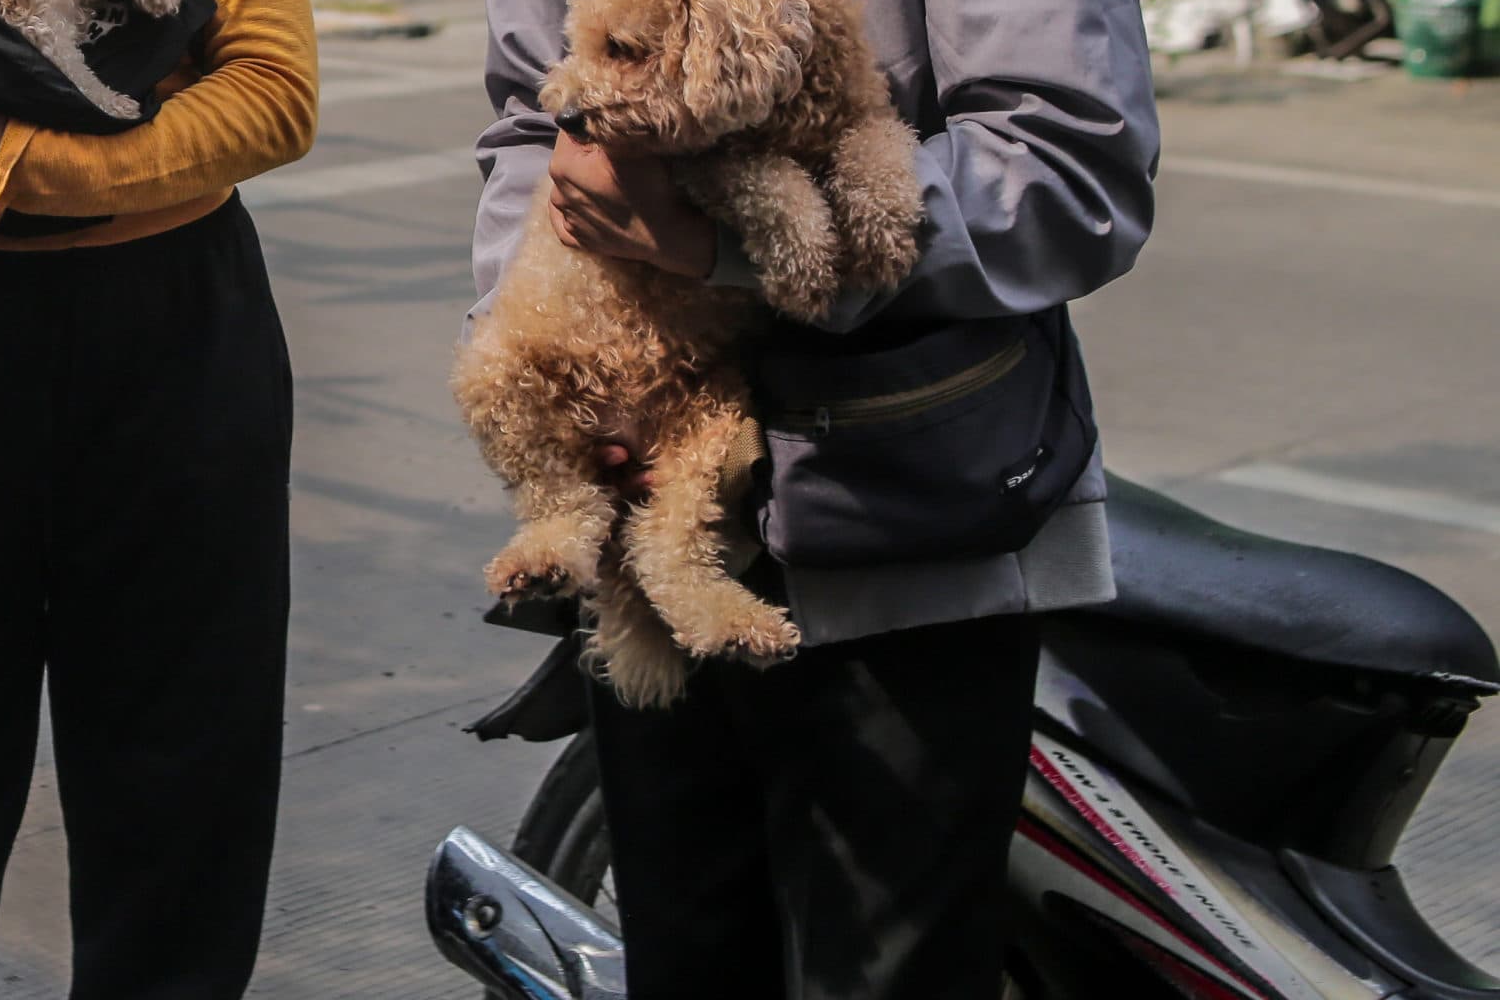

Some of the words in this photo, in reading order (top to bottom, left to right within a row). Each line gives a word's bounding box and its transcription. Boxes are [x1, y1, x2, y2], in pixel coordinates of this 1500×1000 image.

[1051, 750, 1098, 789] NEW
[1107, 806, 1187, 879] STROKE
[1181, 882, 1261, 952] ENGINE
